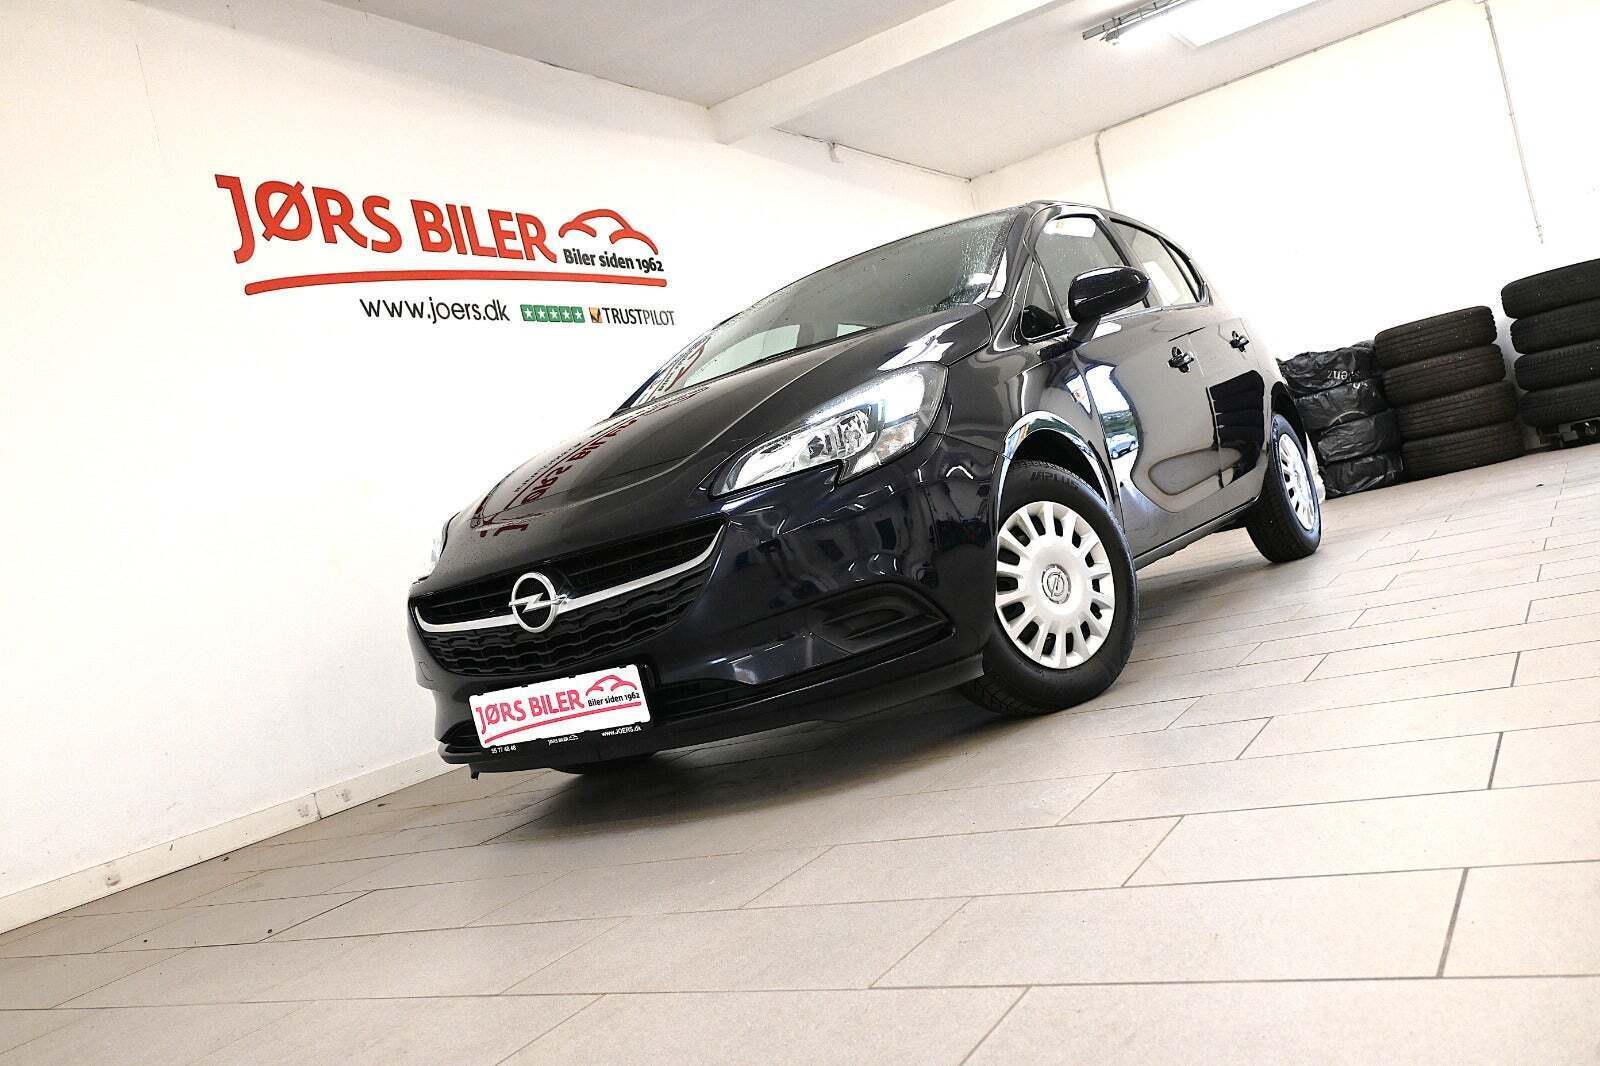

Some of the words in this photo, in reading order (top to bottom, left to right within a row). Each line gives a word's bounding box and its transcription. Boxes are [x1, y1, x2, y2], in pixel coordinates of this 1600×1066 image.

[214, 174, 403, 264] JØRS
[410, 199, 557, 264] BILER
[563, 247, 596, 267] Biler
[598, 251, 635, 269] siden
[636, 256, 664, 273] 1962
[359, 298, 510, 325] www.joers.dk
[602, 307, 675, 326] TRUSTPILOT
[475, 699, 527, 734] JØRS
[528, 689, 585, 718] BILER
[588, 695, 604, 707] Biler
[604, 693, 624, 704] siden
[624, 692, 640, 702] 1962
